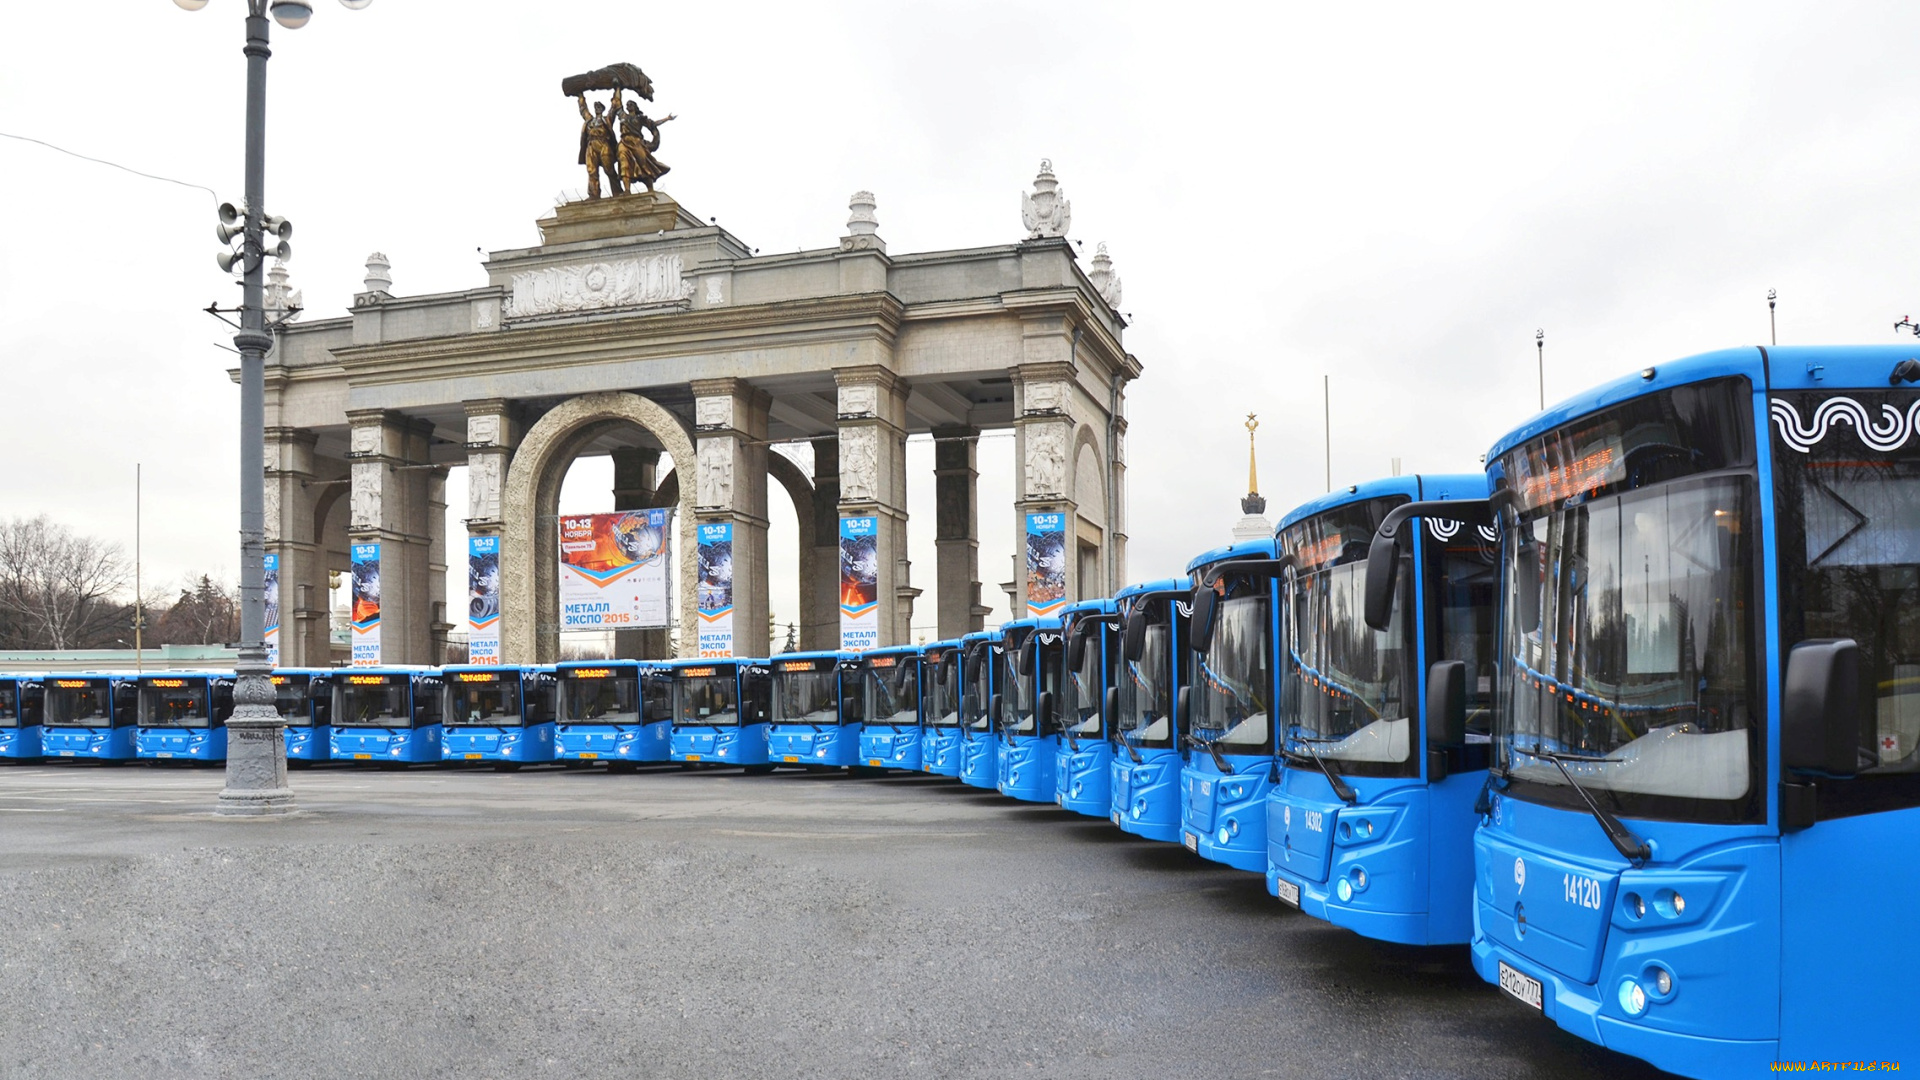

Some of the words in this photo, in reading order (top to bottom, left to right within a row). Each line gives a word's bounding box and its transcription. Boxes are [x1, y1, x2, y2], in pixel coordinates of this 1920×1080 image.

[565, 519, 591, 529] 10-13
[846, 519, 871, 528] 10-13
[1032, 515, 1058, 524] 10-13
[565, 530, 592, 538] НОЯБРЯ
[703, 526, 726, 535] 10-13
[473, 539, 494, 547] 10-13
[356, 546, 375, 554] 10-13
[565, 603, 610, 613] МЕТАЛЛ
[700, 642, 726, 650] ЭКСПО
[842, 639, 870, 647] ЭКСПО
[1305, 810, 1322, 832] 14302
[1563, 873, 1600, 910] 14120
